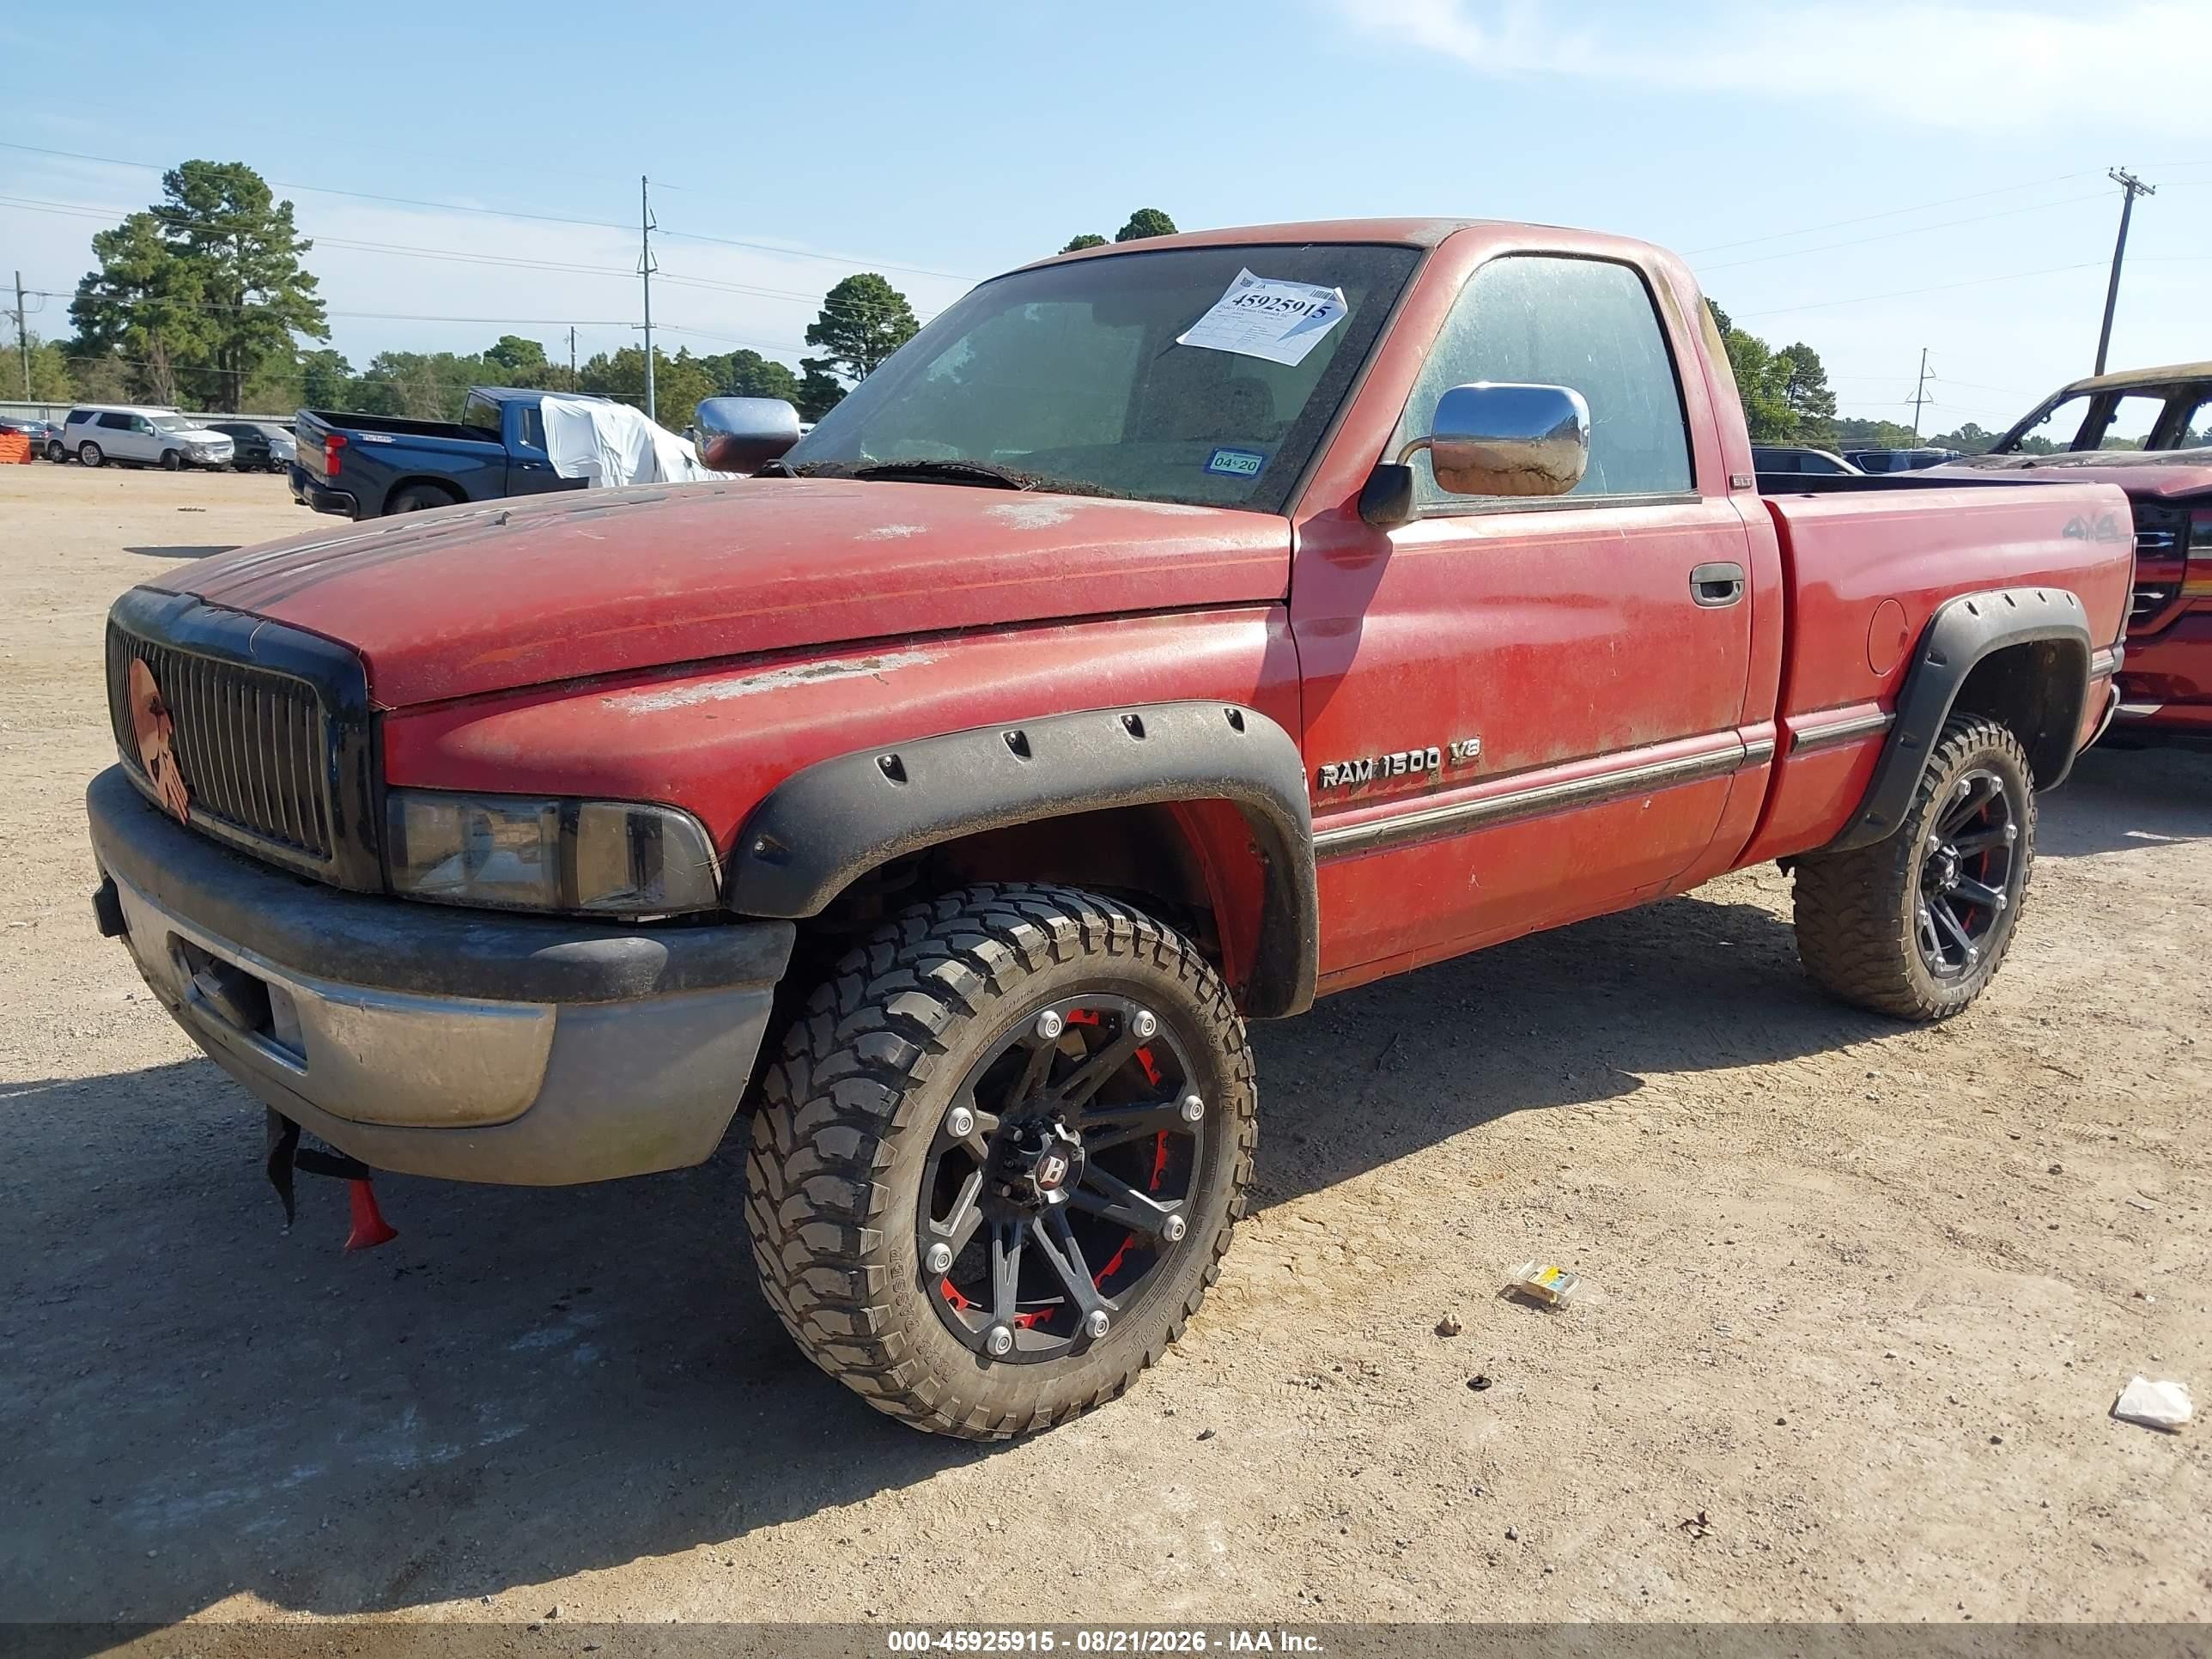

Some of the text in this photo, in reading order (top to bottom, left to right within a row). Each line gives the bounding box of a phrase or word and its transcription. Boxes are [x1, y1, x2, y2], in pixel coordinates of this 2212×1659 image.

[1231, 293, 1334, 319] 45925915
[1320, 738, 1481, 790] RAM 1500 V8
